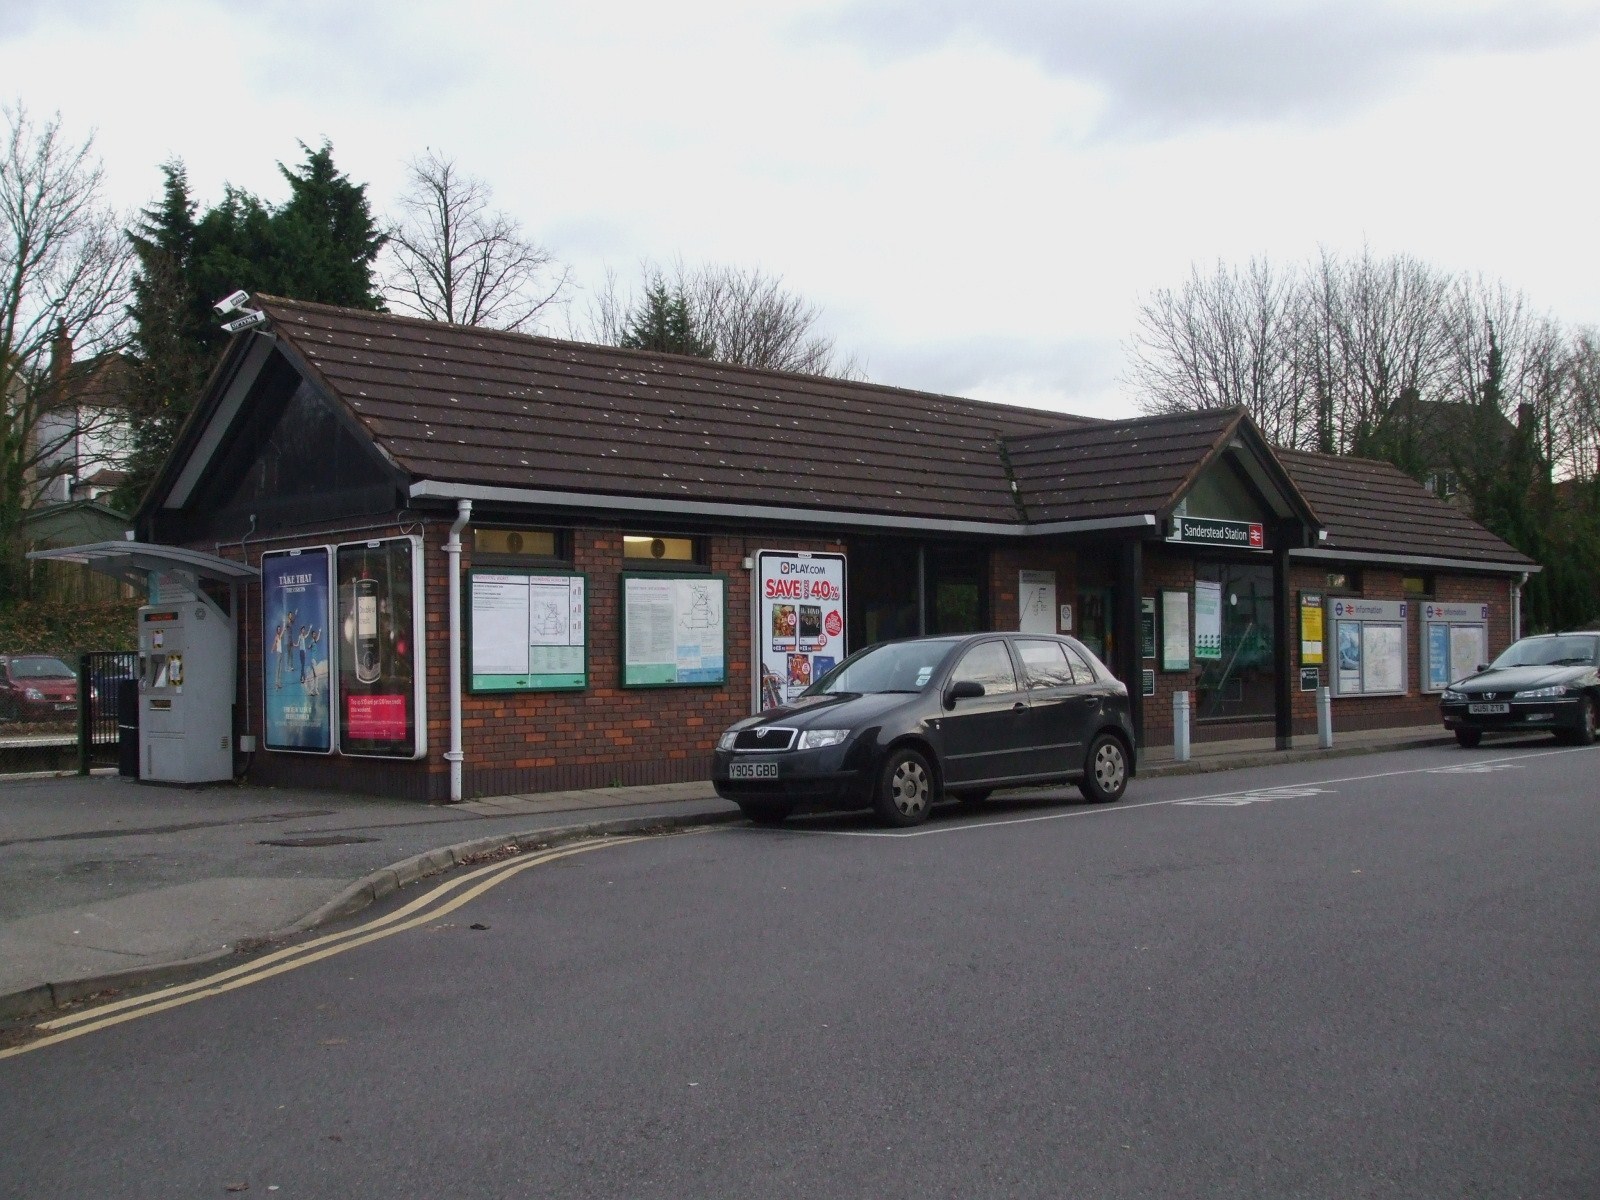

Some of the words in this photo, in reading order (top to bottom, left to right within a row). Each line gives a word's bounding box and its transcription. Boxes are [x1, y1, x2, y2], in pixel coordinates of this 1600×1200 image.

[231, 315, 257, 329] OPTYMA
[1184, 523, 1224, 540] Sanderstead
[1224, 527, 1248, 541] Station
[790, 563, 826, 575] PLAY.COM
[278, 576, 295, 585] TAKE
[296, 573, 313, 583] THAT
[766, 578, 801, 598] SAVE
[811, 580, 840, 600] 40%
[1356, 604, 1384, 615] Information
[1490, 704, 1505, 713] ZTR
[730, 764, 754, 777] Y905
